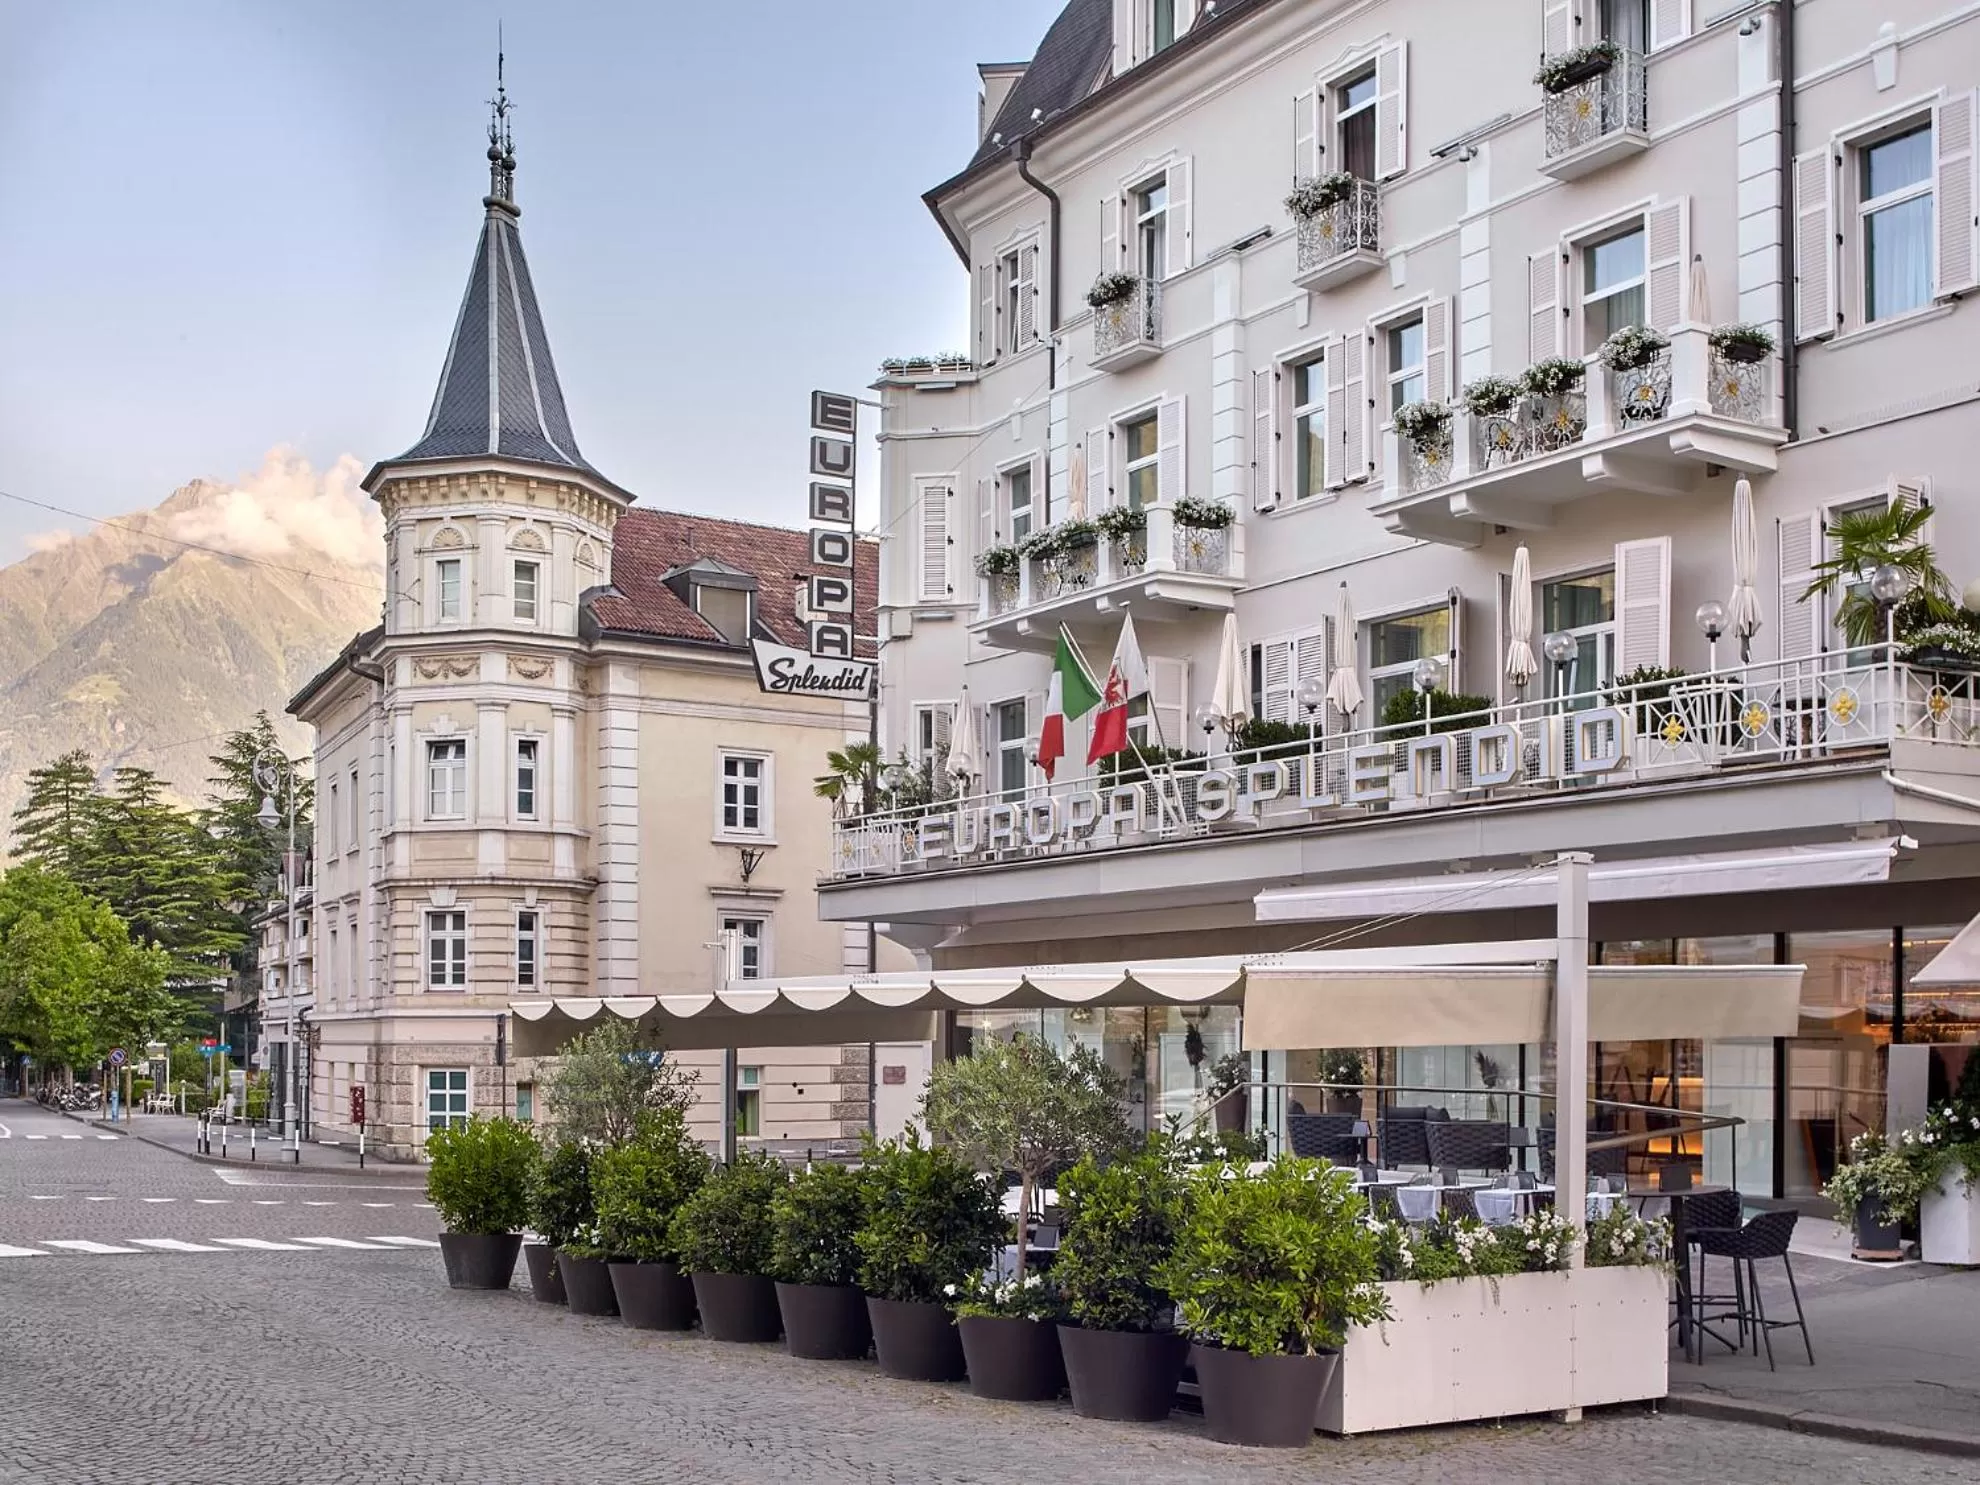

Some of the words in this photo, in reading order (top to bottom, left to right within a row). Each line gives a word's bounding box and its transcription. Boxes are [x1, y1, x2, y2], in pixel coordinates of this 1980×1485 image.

[816, 396, 855, 655] EUROPA
[768, 657, 869, 693] Splendid
[918, 783, 1146, 860] EUROPA
[1197, 706, 1630, 822] SPLENDID
